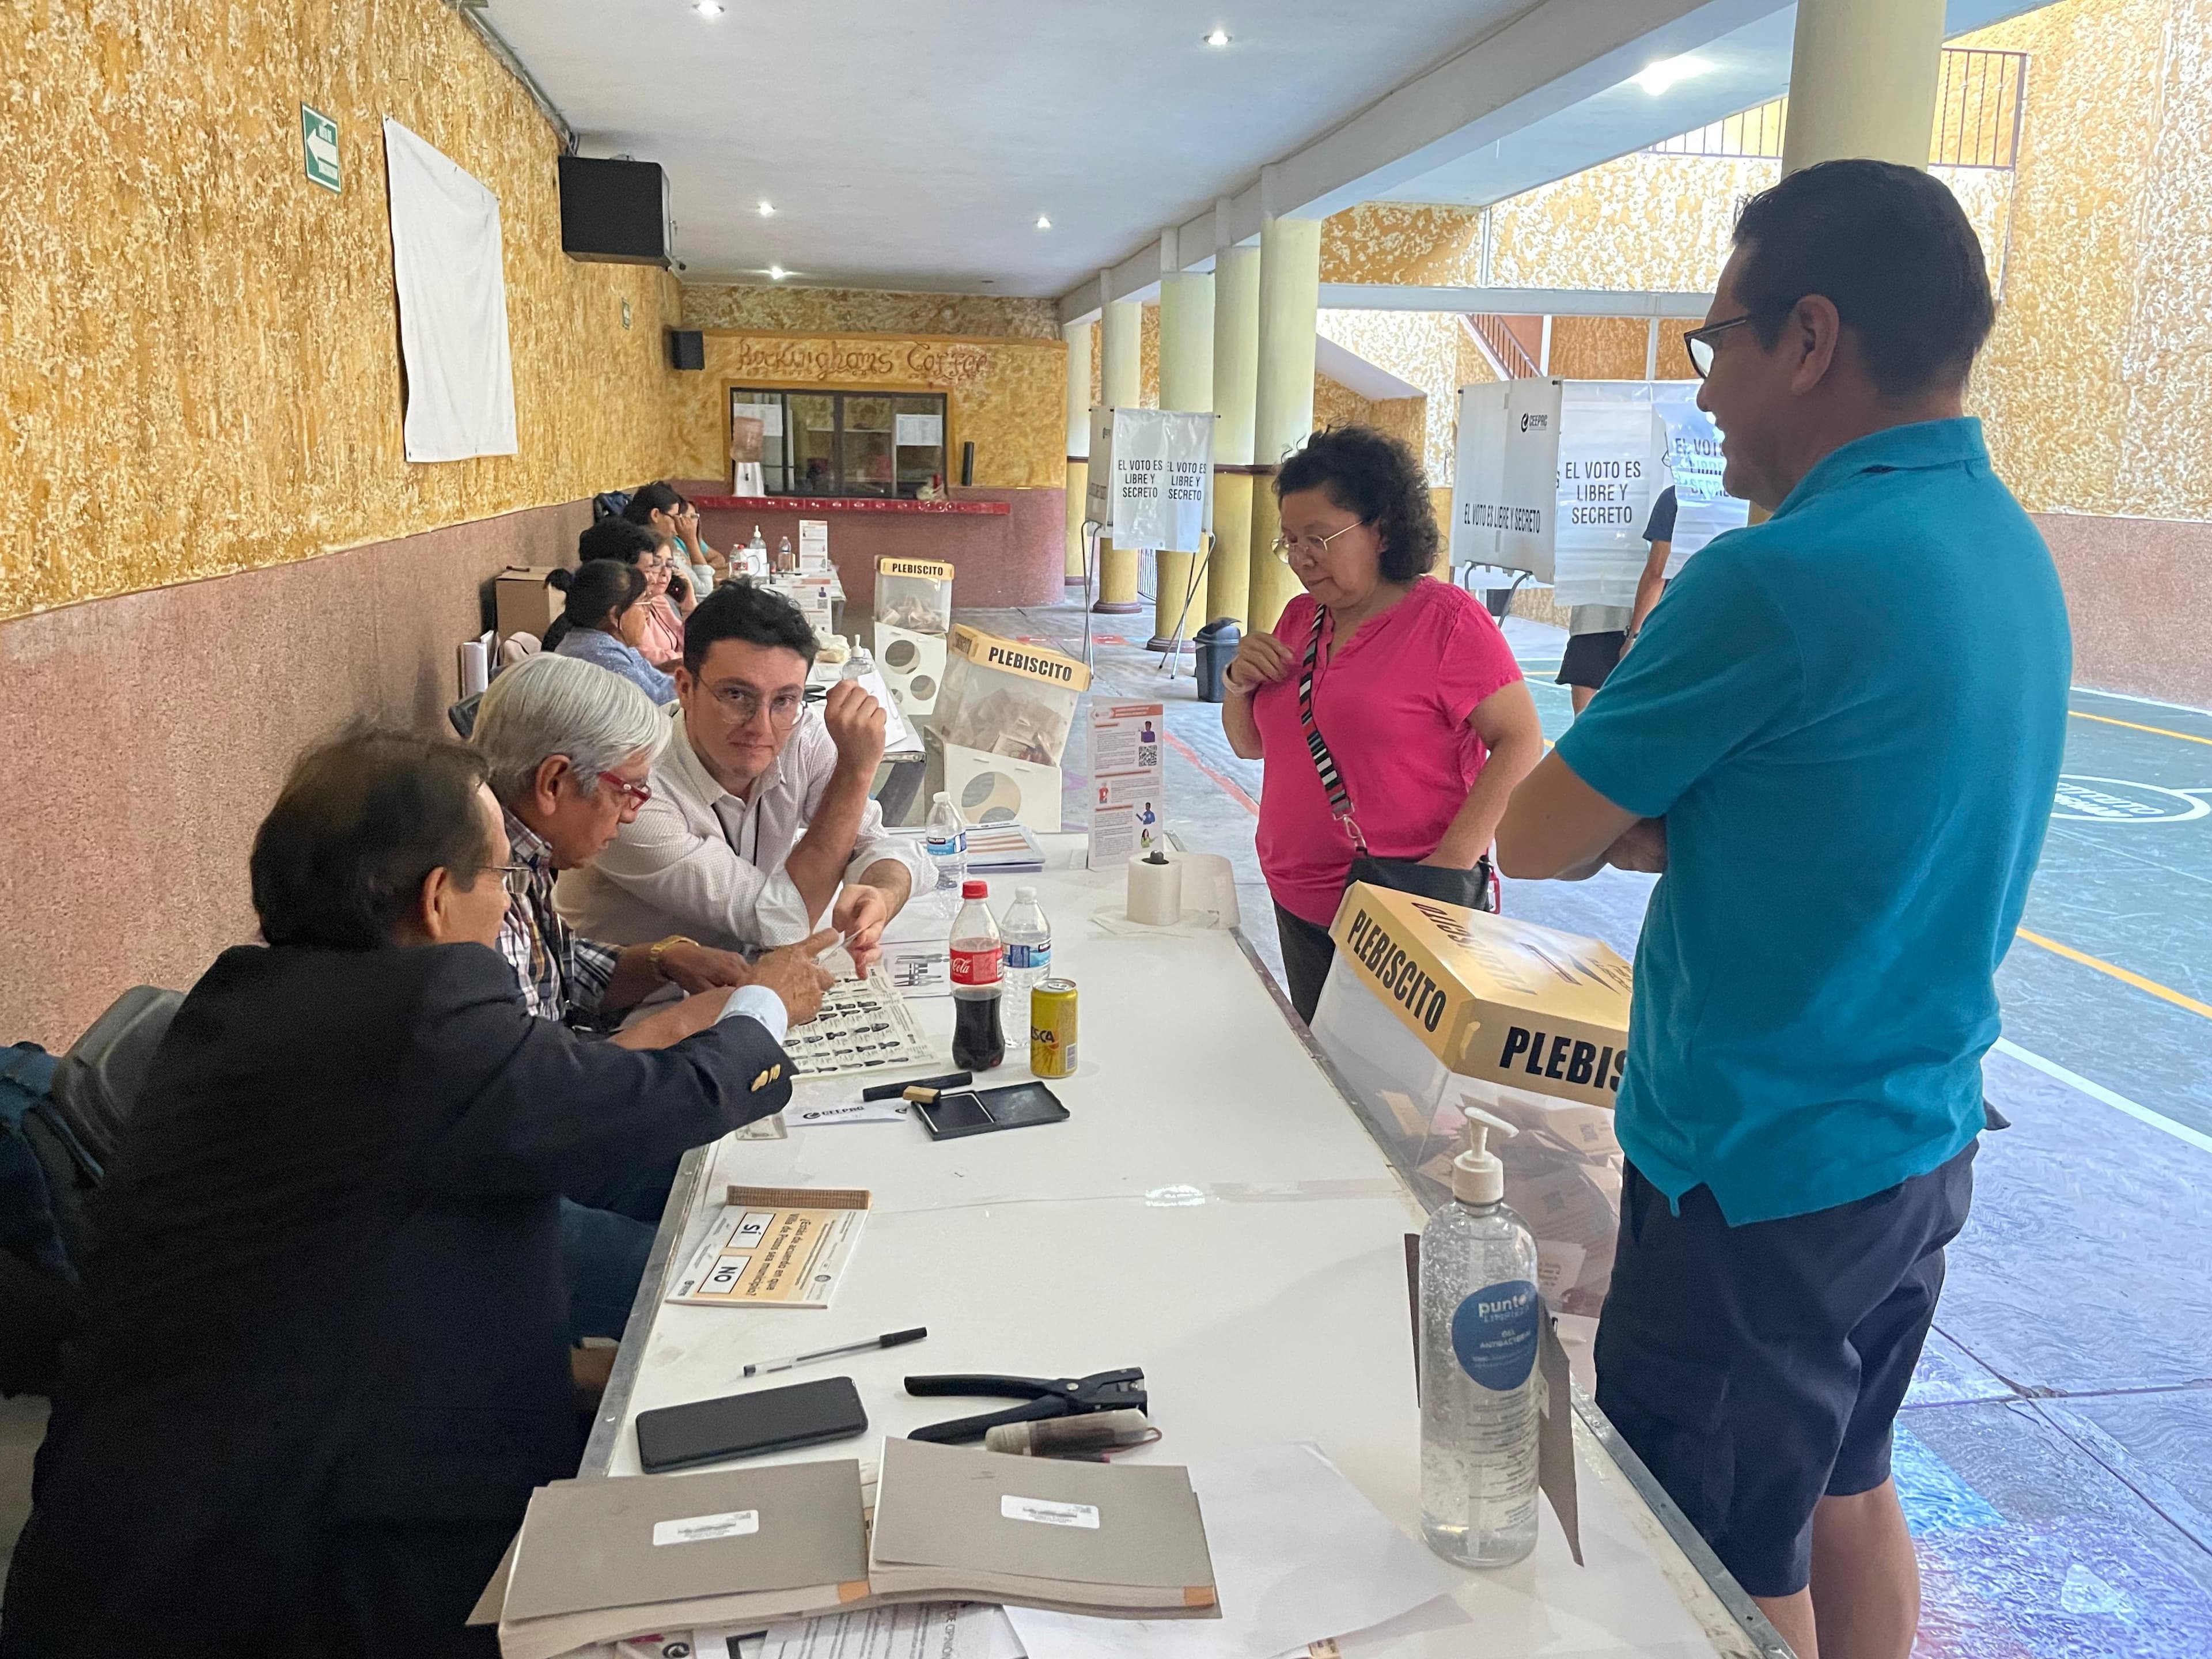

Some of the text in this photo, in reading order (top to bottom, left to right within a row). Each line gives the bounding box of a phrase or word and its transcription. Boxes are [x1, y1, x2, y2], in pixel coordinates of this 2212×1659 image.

[1694, 438, 1725, 457] VOT
[1118, 460, 1162, 471] EL VOTO ES
[1177, 461, 1197, 474] VOTO
[1199, 463, 1206, 474] ES
[1566, 460, 1641, 479] EL VOTO ES
[1125, 474, 1156, 484] LIBRE Y
[1171, 475, 1201, 487] LIBRE Y
[1123, 487, 1158, 498] SECRETO
[1168, 488, 1202, 501] SECRETO
[1577, 483, 1628, 502] LIBRE Y
[1464, 503, 1540, 534] EL VOTO ES LIBRE Y SECRETO
[1572, 506, 1632, 524] SECRETO
[892, 562, 944, 576] PLEBISCITO
[988, 646, 1073, 682] PLEBISCITO
[1347, 908, 1446, 1032] PLEBISCITO
[741, 1224, 762, 1236] SÍ
[714, 1266, 738, 1283] NO
